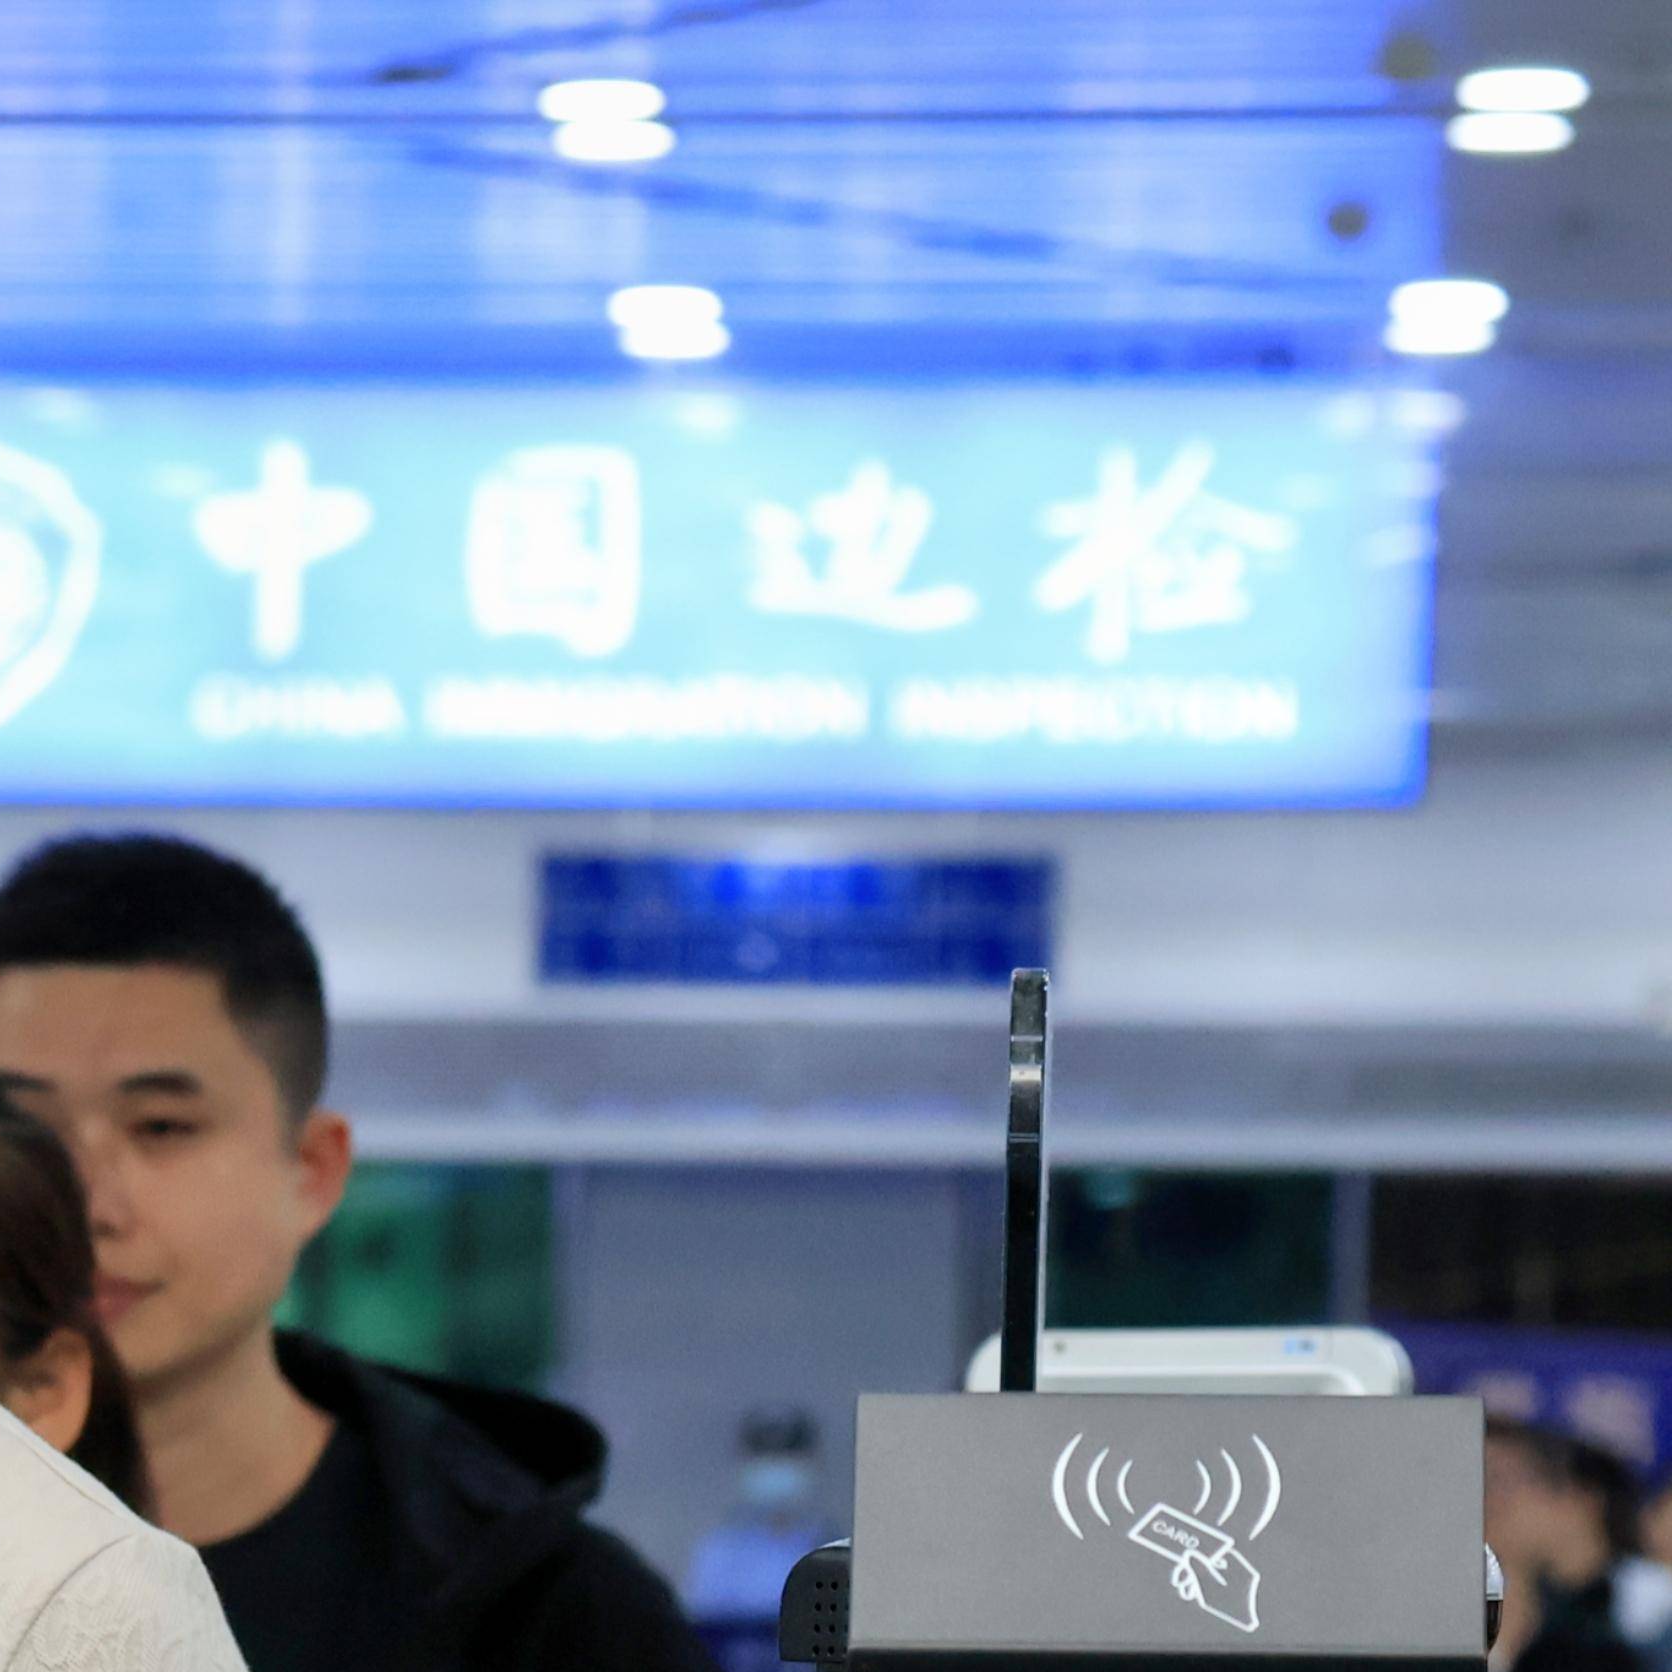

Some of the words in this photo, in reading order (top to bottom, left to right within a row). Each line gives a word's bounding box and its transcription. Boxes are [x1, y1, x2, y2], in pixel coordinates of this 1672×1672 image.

[190, 435, 1299, 666] 中国边检
[187, 673, 407, 743] CHINA
